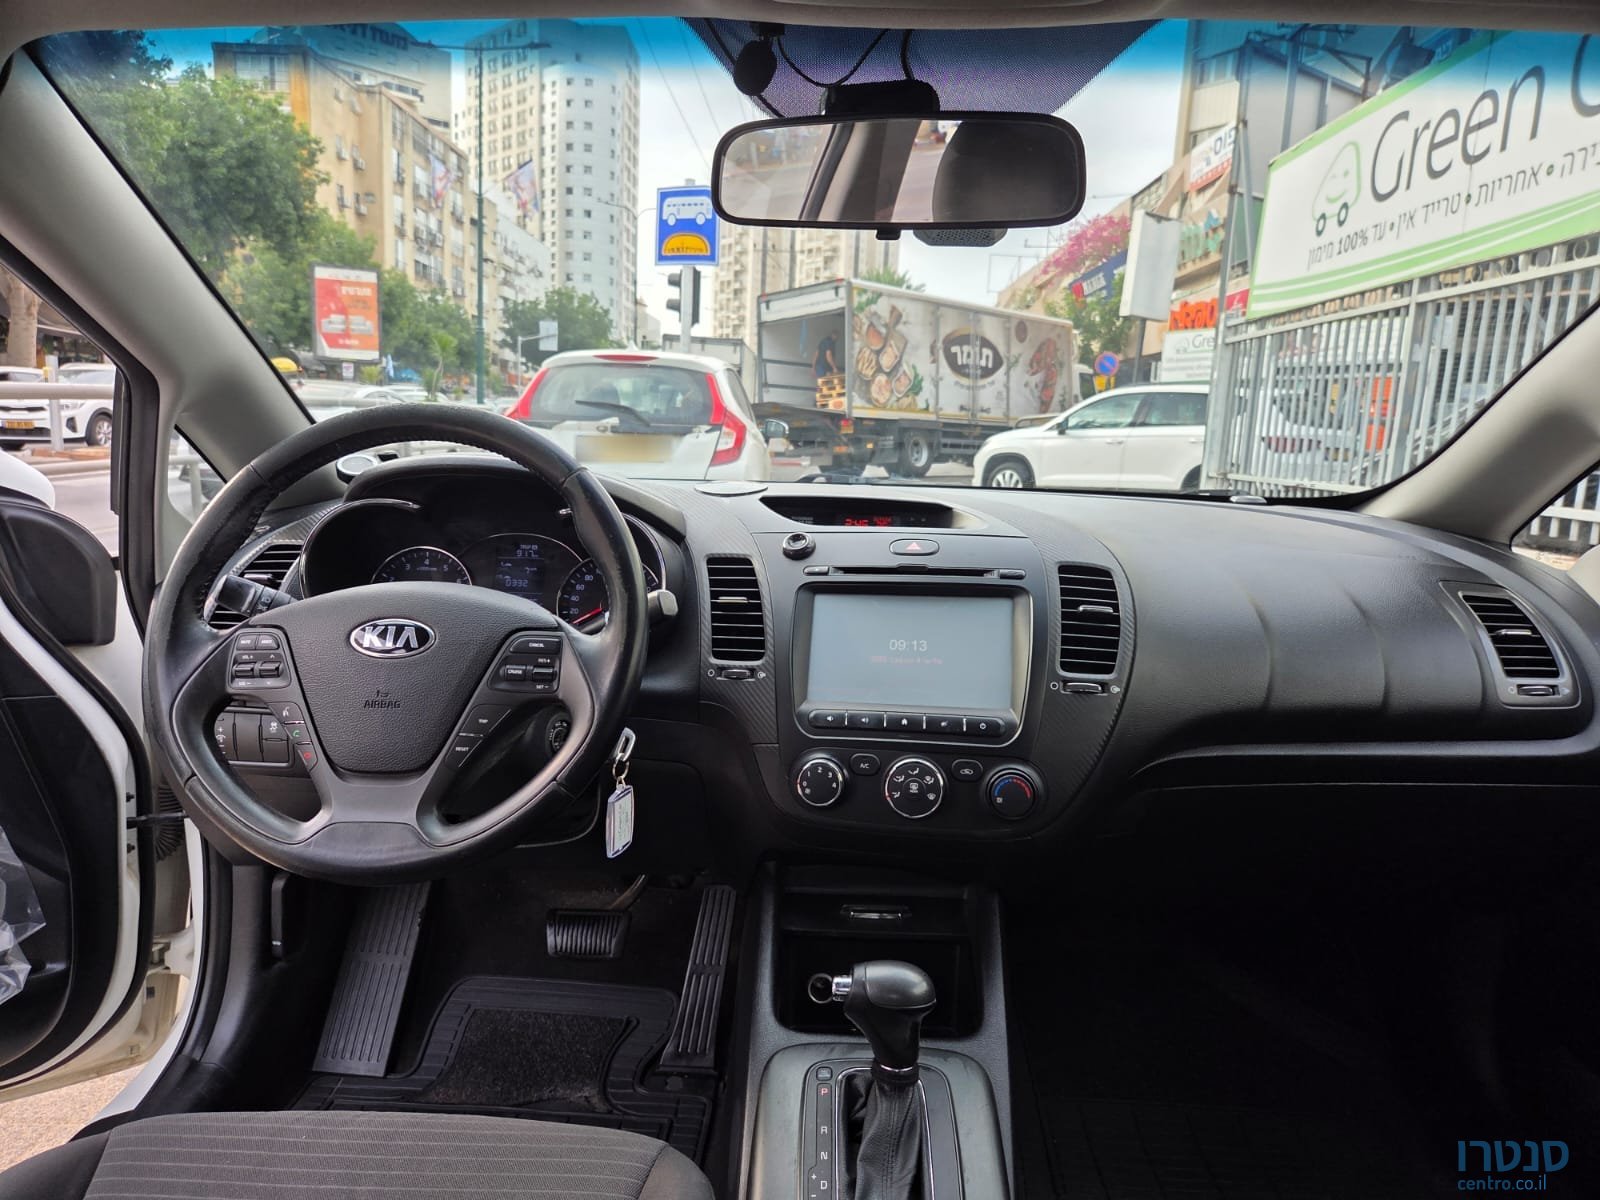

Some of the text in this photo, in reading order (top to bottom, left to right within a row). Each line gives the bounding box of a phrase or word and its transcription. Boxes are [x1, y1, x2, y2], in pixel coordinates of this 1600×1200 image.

[1371, 65, 1546, 203] Green
[1560, 142, 1600, 179] ירה
[1474, 162, 1543, 208] אחריות
[1421, 192, 1462, 225] טרייד
[1336, 226, 1369, 256] 100%
[1306, 241, 1335, 272] מימון
[443, 564, 449, 572] 5
[569, 607, 579, 615] 20
[362, 625, 419, 649] KIA
[888, 639, 928, 652] 09:13
[363, 699, 401, 709] AIRBAG
[821, 1088, 828, 1096] P
[820, 1126, 828, 1135] R
[820, 1152, 828, 1160] N
[820, 1181, 828, 1190] D
